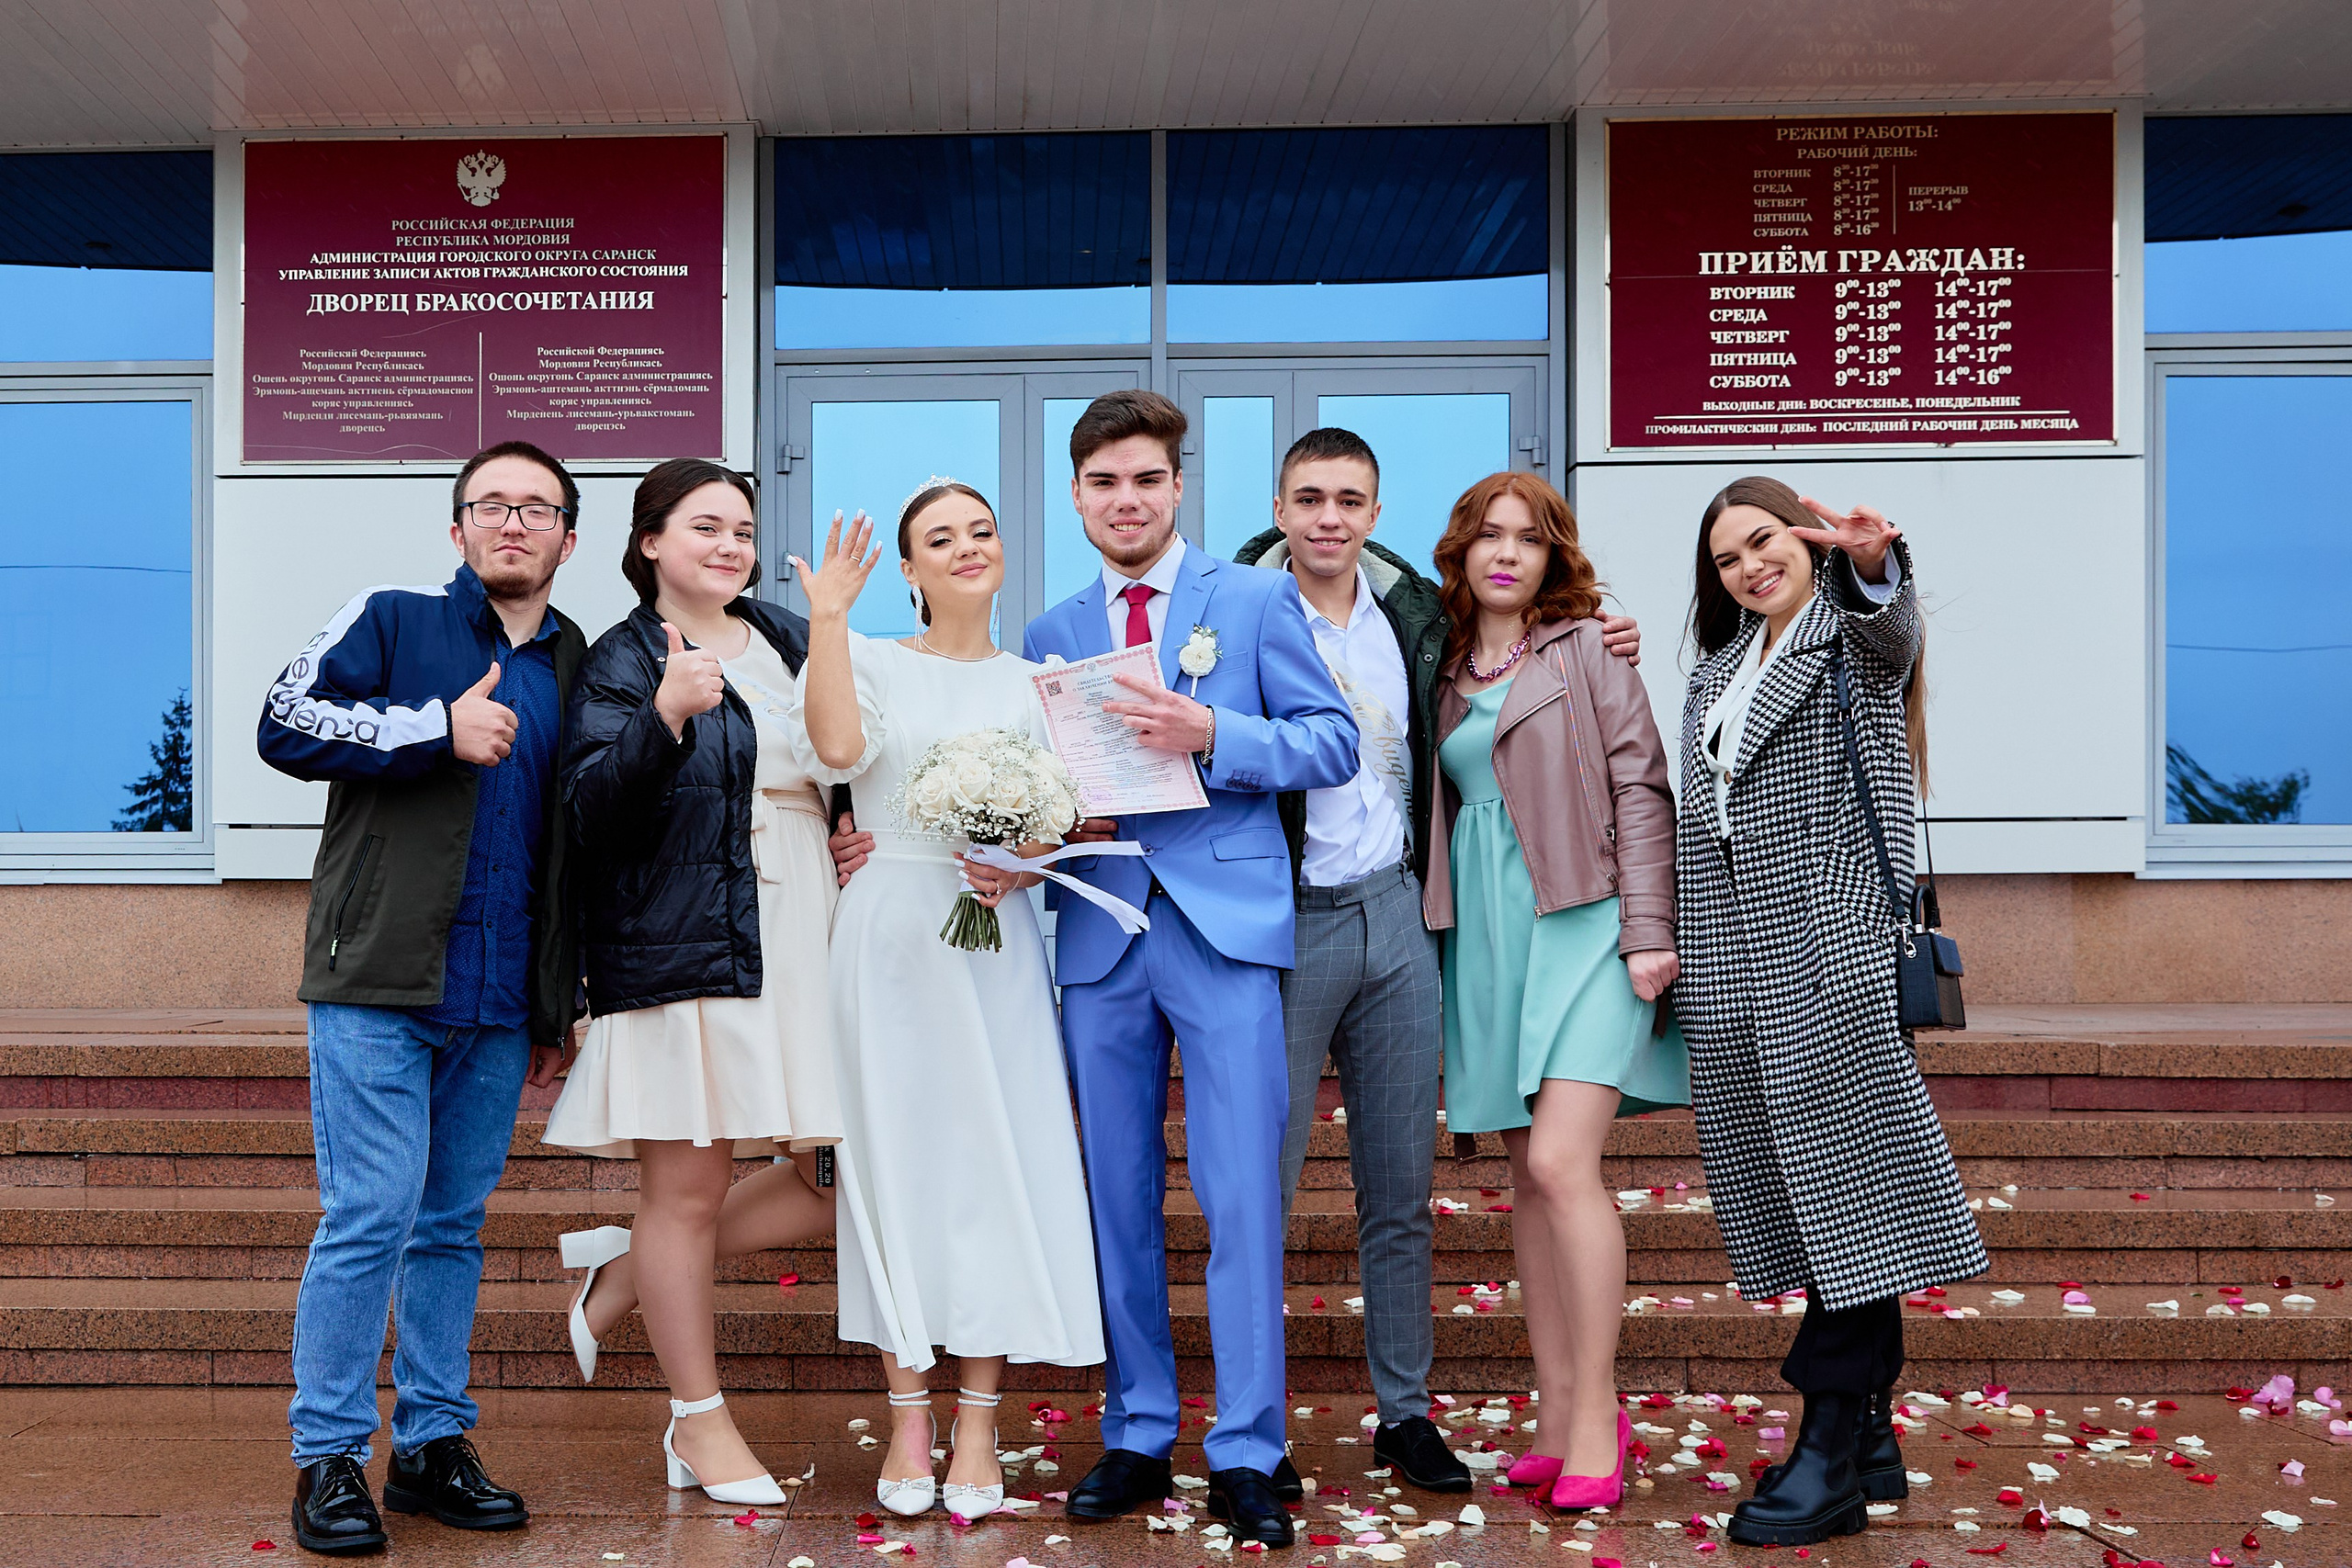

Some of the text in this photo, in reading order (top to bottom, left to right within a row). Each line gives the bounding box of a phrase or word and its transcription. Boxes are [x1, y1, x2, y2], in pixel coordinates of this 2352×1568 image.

[1777, 125, 1939, 141] РЕЖИМ РАБОТЫ:
[1797, 145, 1917, 160] РАБОЧИЙ ДЕНЬ:
[1754, 169, 1812, 178] ВТОРНИК
[1753, 184, 1792, 194] СРЕДА
[1908, 186, 1969, 196] ПЕРЕРЫВ
[1753, 198, 1808, 208] ЧЕТВЕРГ
[1753, 213, 1813, 222] ПЯТНИЦА
[391, 218, 574, 231] РОССИЙСКАЯ ФЕДЕРАЦИЯ
[1753, 228, 1809, 237] СУББОТА
[396, 234, 570, 246] РЕСПУБЛИКА МОРДОВИЯ
[310, 249, 656, 265] АДМИНИСТРАЦИЯ ГОРОДСКОГО ОКРУГА САРАНСК
[1699, 245, 2026, 276] ПРИЁМ ГРАЖДАН:
[278, 265, 688, 280] УПРАВЛЕНИЕ ЗАПИСИ АКТОВ ГРАЖДАНСКОГО СОСТОЯНИЯ
[1709, 286, 1794, 300] ВТОРНИК
[306, 291, 654, 316] ДВОРЕЦ БРАКОСОЧЕТАНИЯ
[1709, 308, 1768, 322] СРЕДА
[1709, 330, 1789, 344] ЧЕТВЕРГ
[360, 349, 426, 359] Федерациясь
[537, 346, 664, 357] Российской Федерациясь
[538, 358, 662, 369] Мордовия Республикась
[1709, 352, 1796, 367] ПЯТНИЦА
[301, 361, 424, 371] Мордовия Республикась
[253, 374, 474, 385] Ошень округонь Саранск администрациясь
[489, 371, 713, 383] Ошонь округонь Саранск администрациясь
[1709, 374, 1791, 389] СУББОТА
[311, 400, 413, 409] коряс управлениясь
[549, 397, 651, 407] коряс управлениясь
[1702, 396, 2020, 412] ВЫХОДНЫЕ ДНИ: ВОСКРЕСЕНЬЕ, ПОНЕДЕЛЬНИК
[574, 423, 626, 432] дворецэсь
[1781, 423, 1816, 434] ДЕНЬ:
[1822, 419, 1909, 432] ПОСЛЕДНИЙ
[1980, 419, 2018, 432] ДЕНЬ
[2020, 419, 2079, 431] МЕСЯЦА
